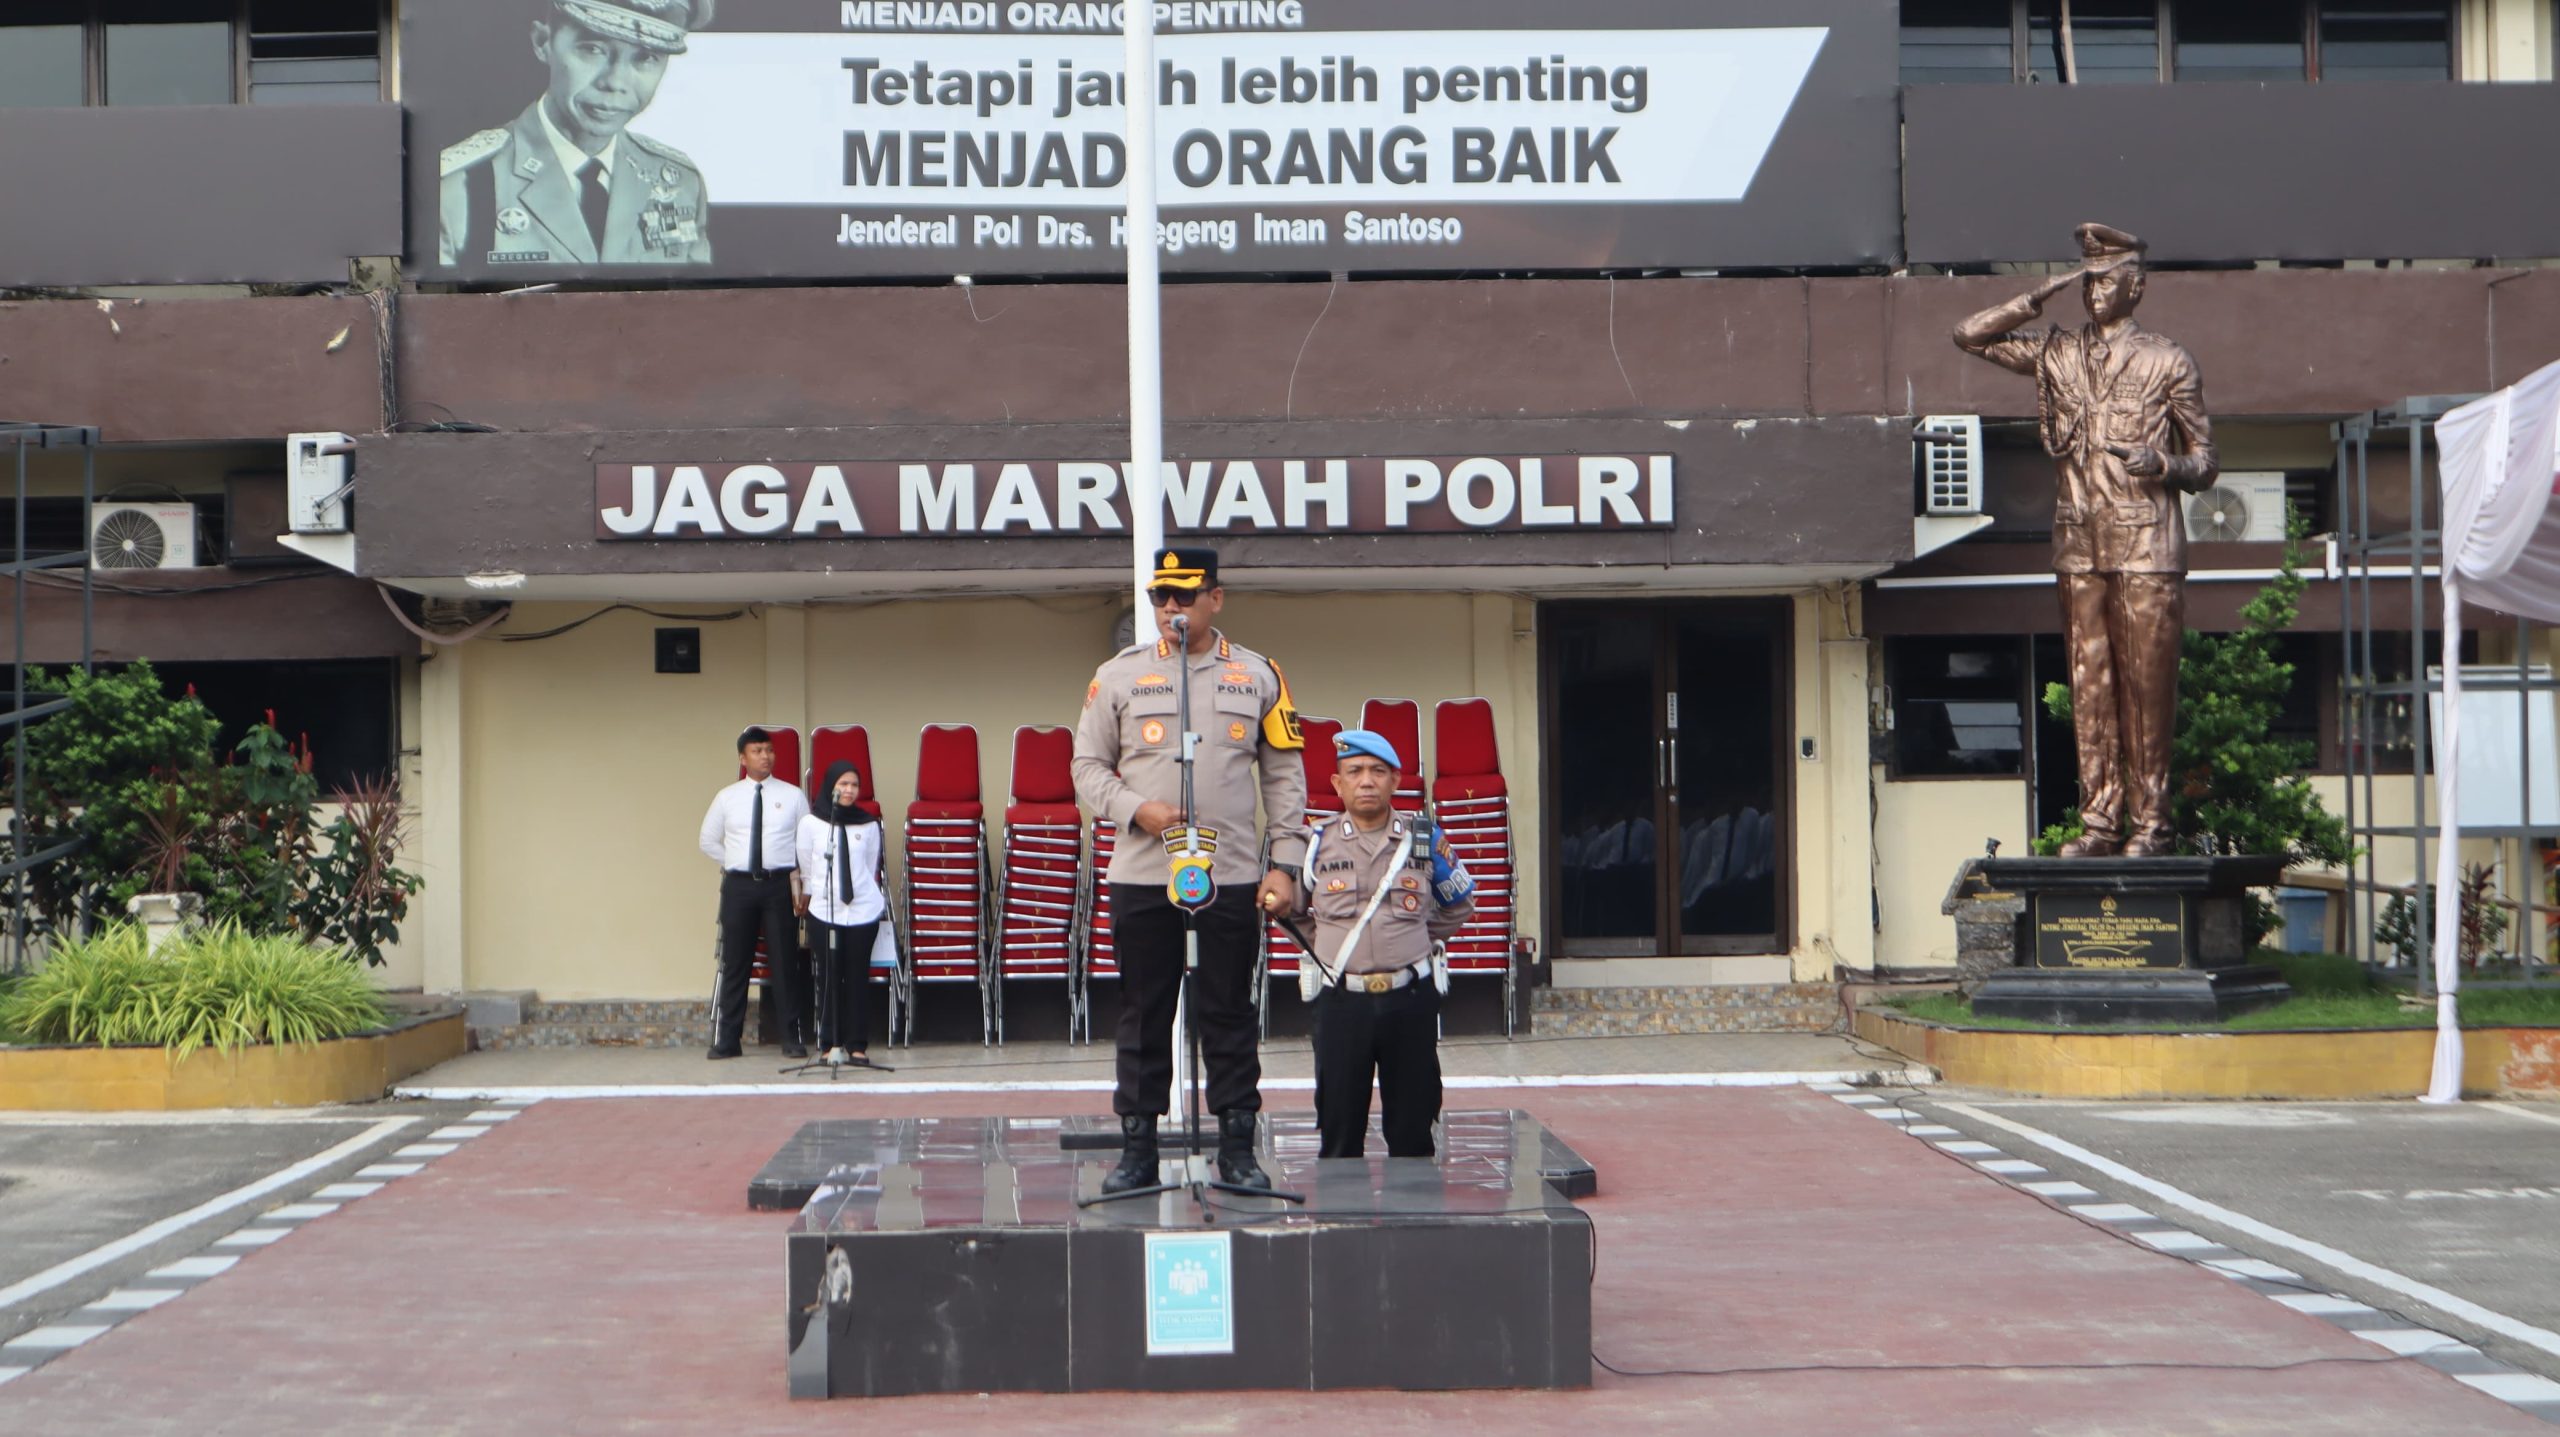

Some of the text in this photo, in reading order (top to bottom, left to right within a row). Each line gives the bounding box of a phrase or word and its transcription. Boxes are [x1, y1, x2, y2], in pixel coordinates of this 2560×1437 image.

[840, 0, 997, 28] MENJADI
[1153, 0, 1303, 26] PENTING
[842, 55, 1649, 117] Tetapi jah lebih penting
[843, 126, 1621, 189] MENJAD ORANG BAIK
[837, 211, 1462, 251] Jenderal Pol Drs. Hegeng Iman Santoso
[601, 456, 1674, 535] JAGA MARWAH POLRI
[1131, 685, 1174, 696] GIDION
[1217, 685, 1258, 696] POLRI
[1319, 859, 1355, 873] AMRI
